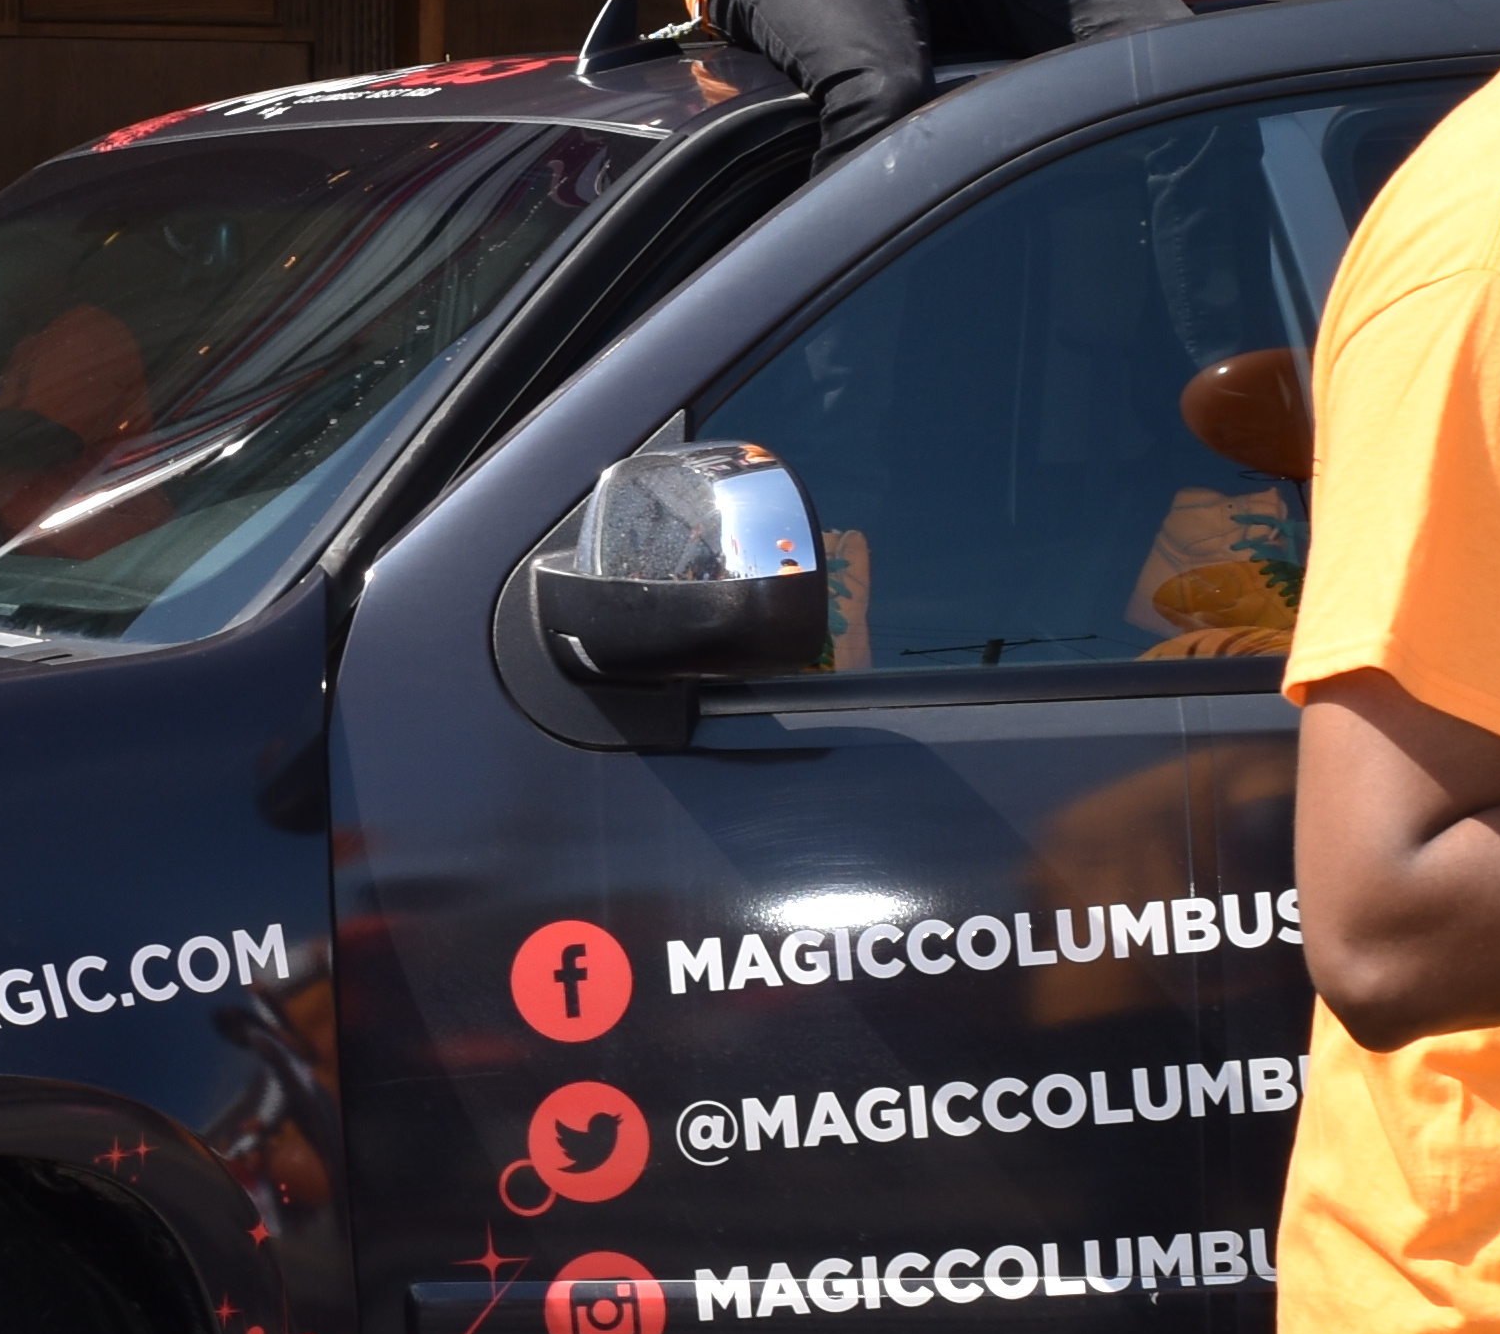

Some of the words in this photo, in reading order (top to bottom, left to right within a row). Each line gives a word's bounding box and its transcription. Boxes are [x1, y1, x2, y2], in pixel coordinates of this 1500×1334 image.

[666, 888, 1306, 995] MAGICCOLUMBUS
[676, 1054, 1310, 1167] @MAGICCOLUMB
[694, 1228, 1279, 1323] MAGICCOLUMBU
